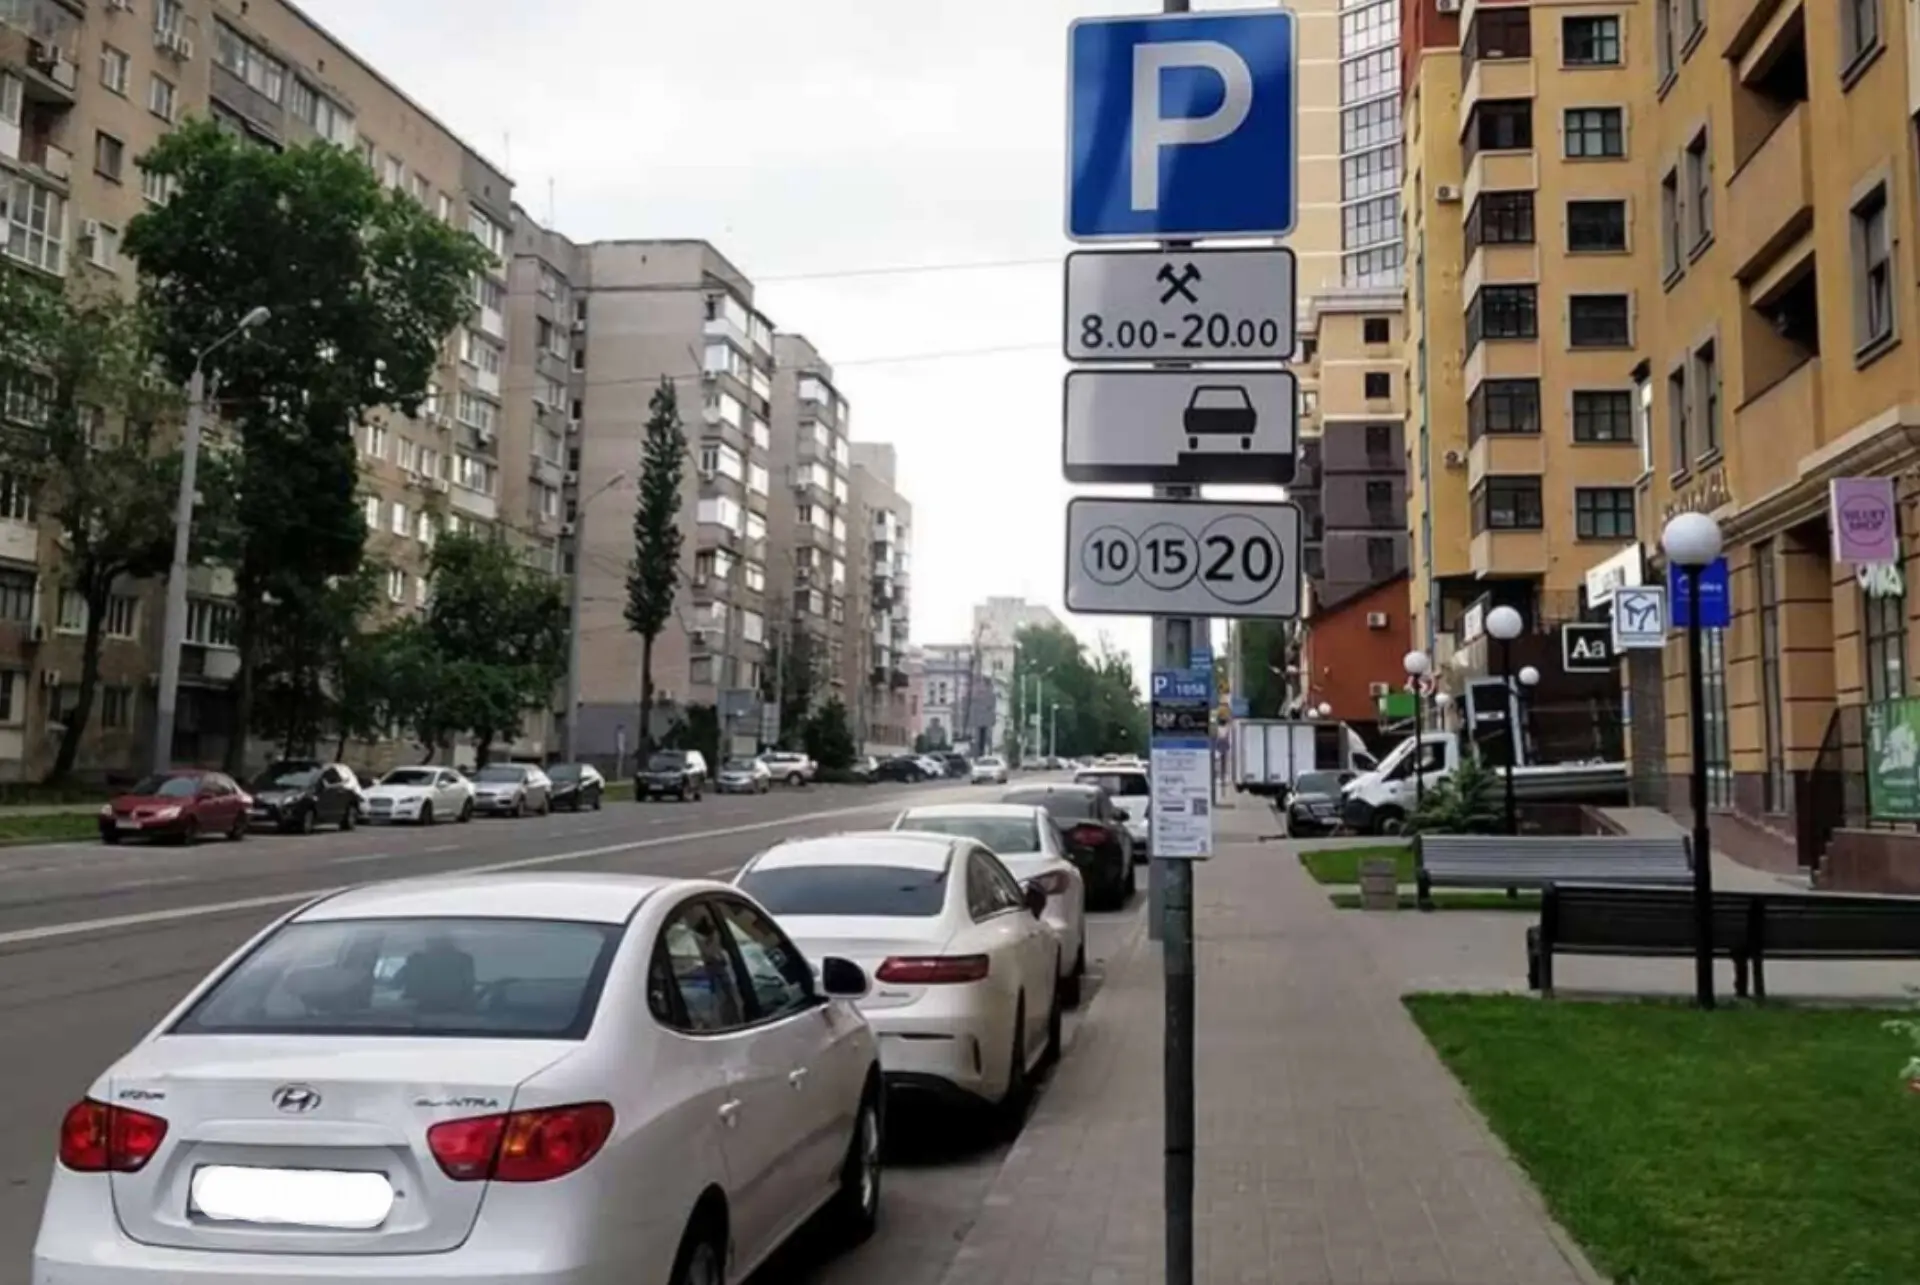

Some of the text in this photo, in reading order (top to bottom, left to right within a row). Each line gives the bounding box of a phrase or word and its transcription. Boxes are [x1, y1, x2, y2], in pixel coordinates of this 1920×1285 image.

[1131, 40, 1253, 212] P
[1081, 312, 1278, 349] 8.00-20.00
[1091, 534, 1274, 582] 10 15 20
[1571, 636, 1606, 659] Aa
[1154, 675, 1168, 695] P
